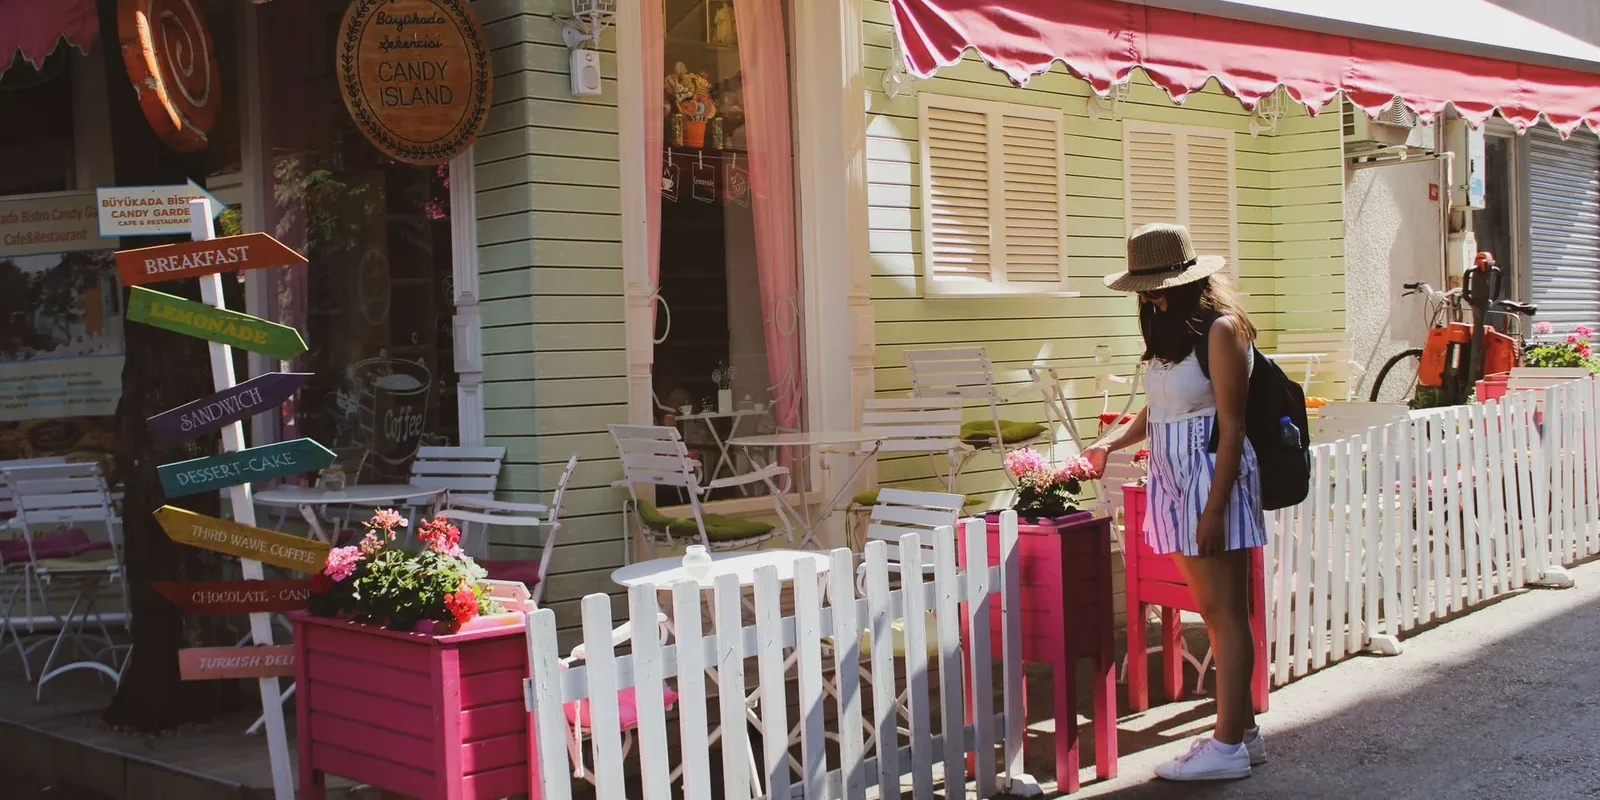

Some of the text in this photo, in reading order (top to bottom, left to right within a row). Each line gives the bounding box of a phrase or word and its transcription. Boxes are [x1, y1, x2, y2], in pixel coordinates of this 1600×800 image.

[378, 60, 448, 81] CANDY
[380, 85, 453, 107] ISLAND
[102, 196, 163, 208] BÜYÜKADA
[111, 207, 190, 218] CANDY GARDE
[0, 205, 98, 225] ada Bistro Candy Ga
[4, 229, 87, 246] Cafe&Restaurant
[144, 245, 249, 275] BREAKFAST
[150, 302, 268, 345] LEMONADE
[180, 387, 263, 431] SANDWICH
[383, 405, 423, 443] Coffee
[176, 452, 297, 486] DESSERT-CAKE
[192, 525, 316, 564] THIRD WAWE COFFEE
[192, 590, 269, 604] CHOCOLATE
[200, 654, 295, 669] TURKISH DELI
